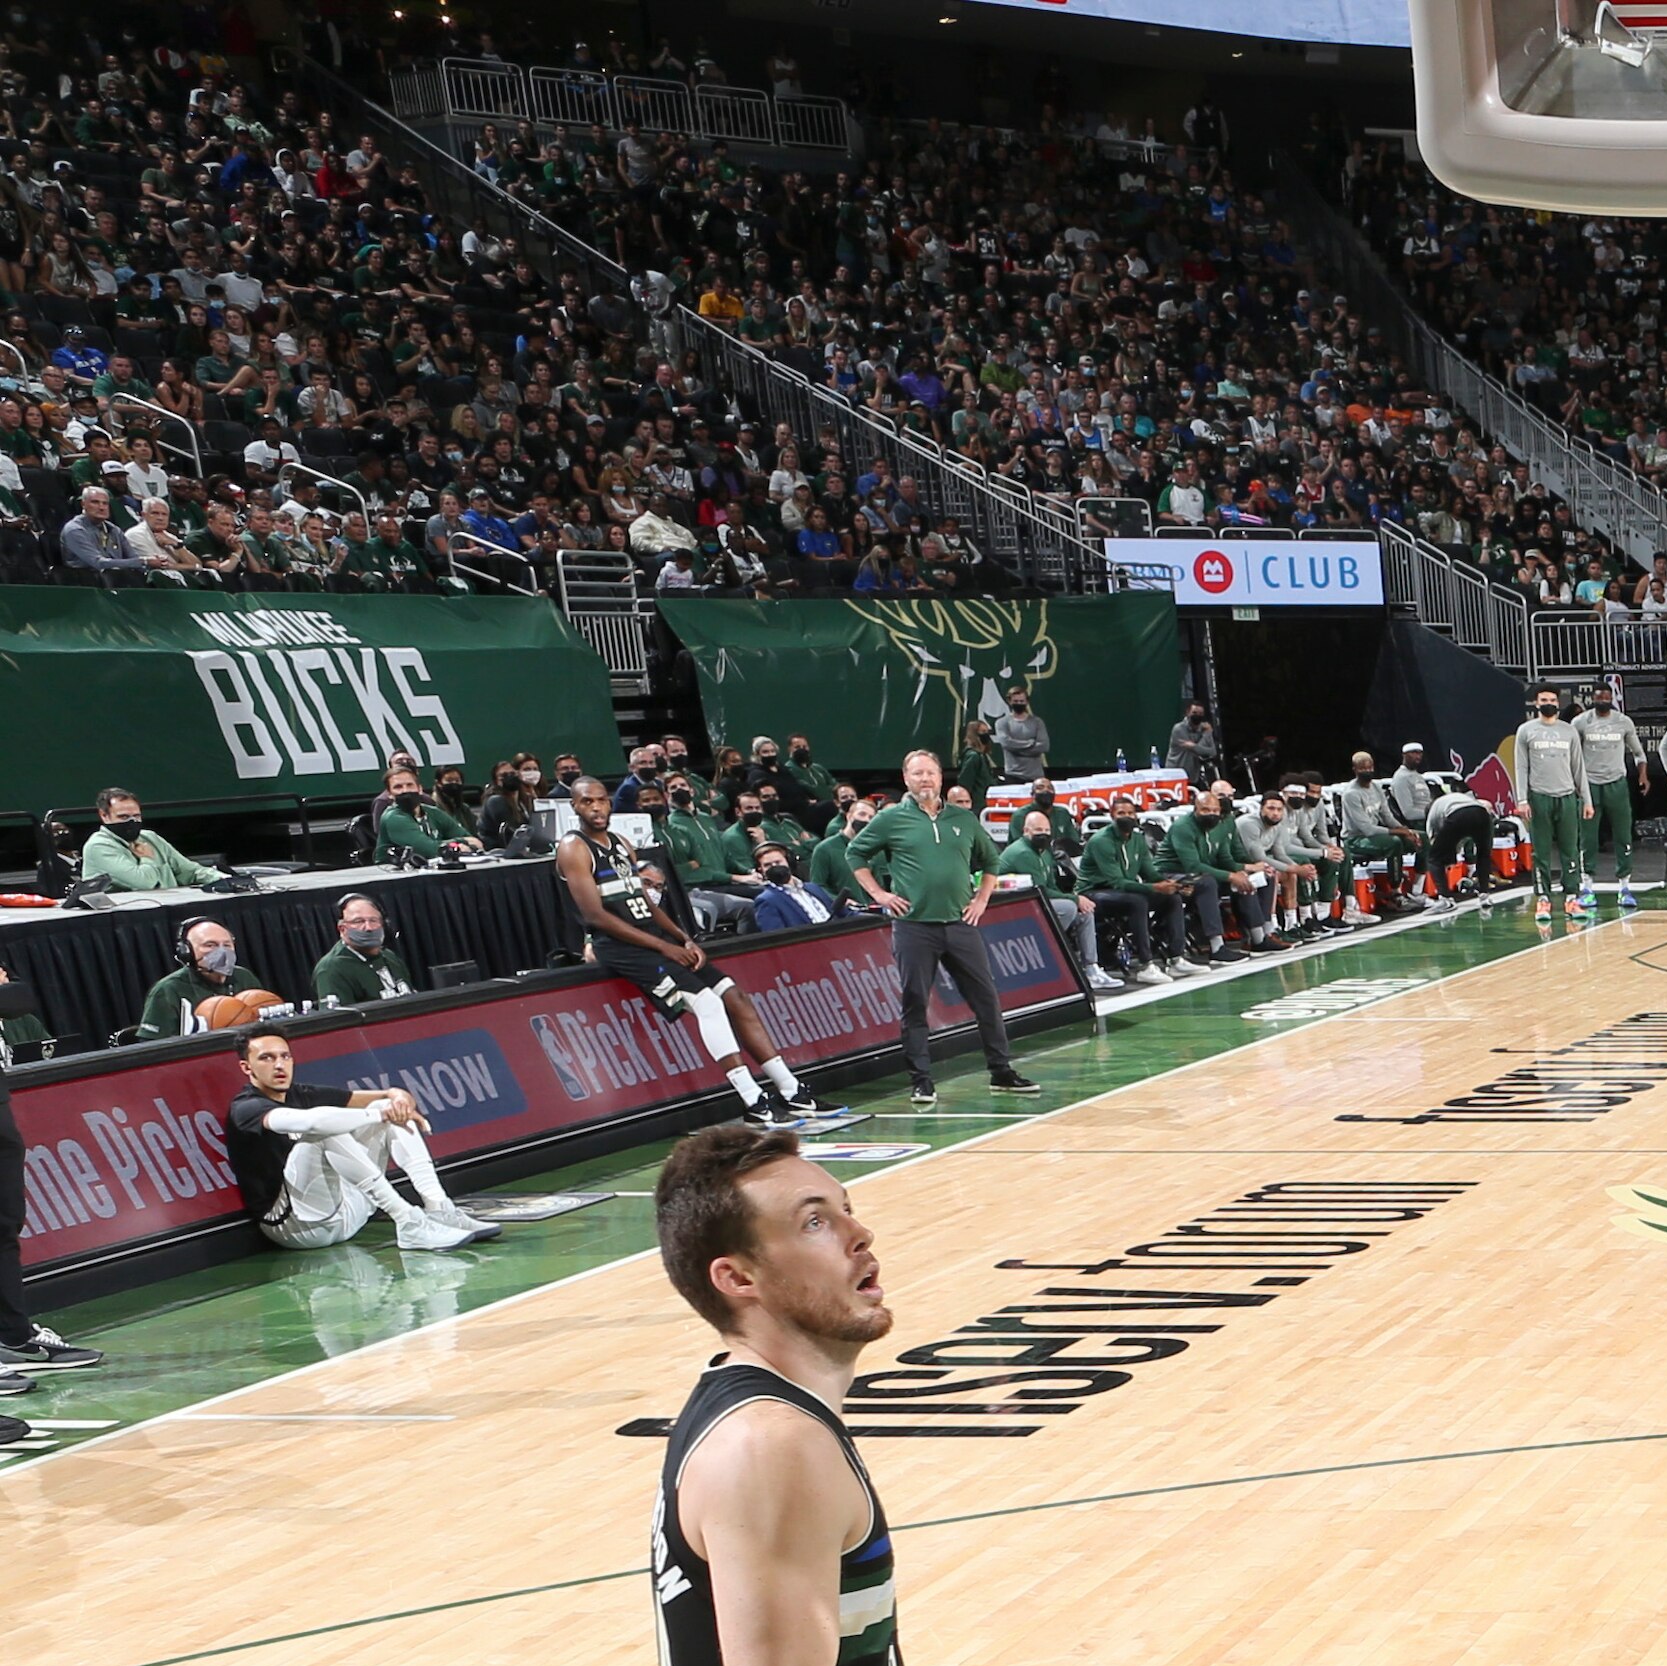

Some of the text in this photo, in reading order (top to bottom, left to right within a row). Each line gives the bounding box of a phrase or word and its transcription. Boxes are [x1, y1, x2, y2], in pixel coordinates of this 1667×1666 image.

[1261, 555, 1360, 589] CLUB
[189, 609, 362, 647] MILWAUKEE
[184, 647, 466, 780] BUCKS
[626, 897, 652, 920] 22
[989, 935, 1046, 977] NOW
[397, 1052, 499, 1116] NOW
[81, 1097, 238, 1211] Picks
